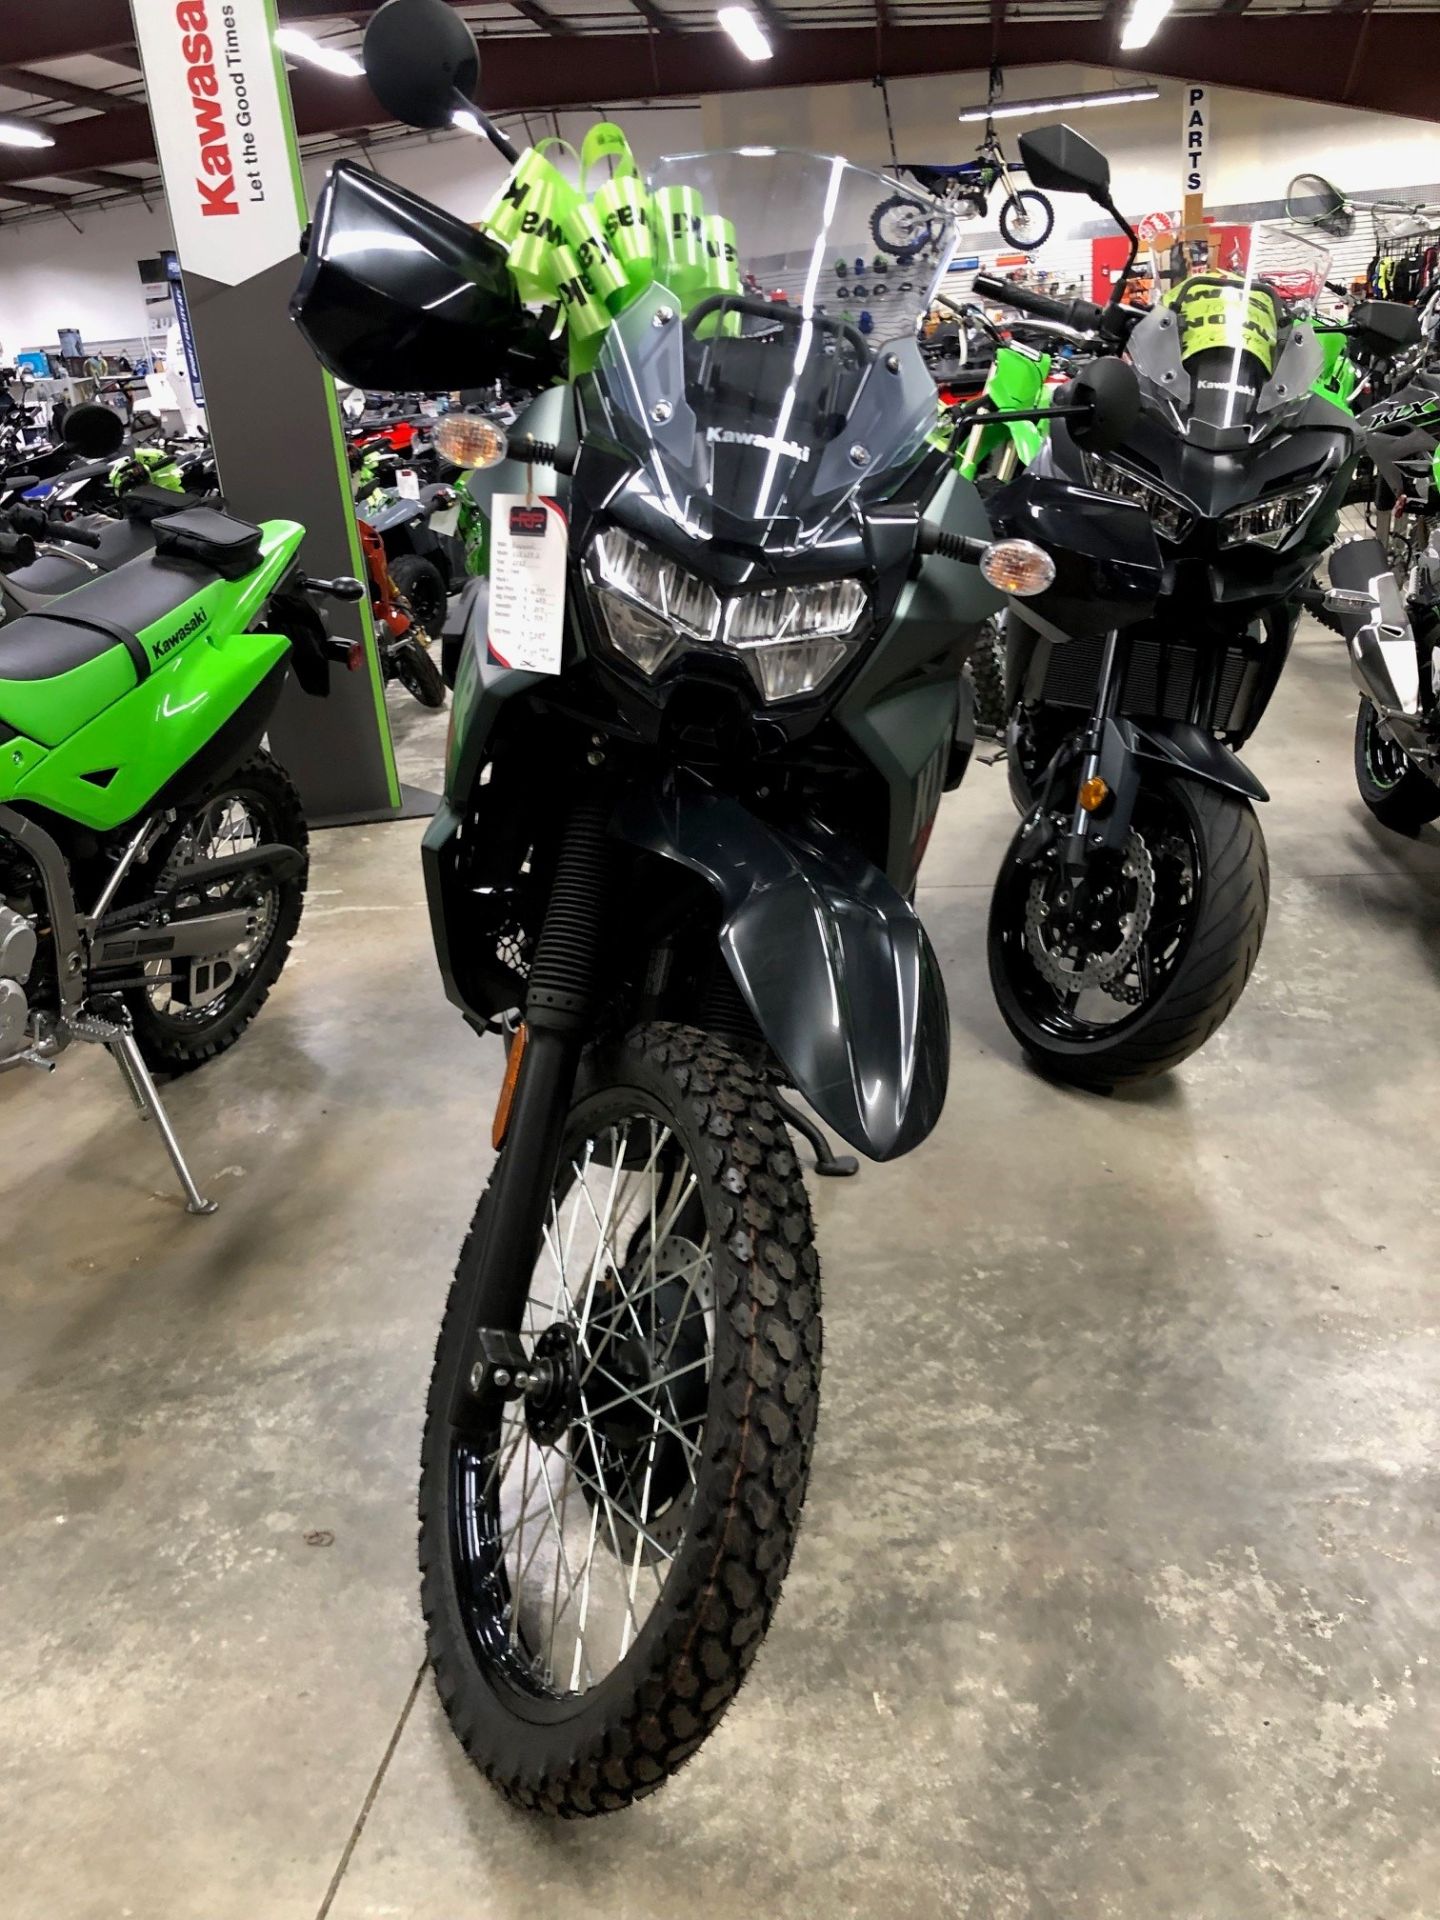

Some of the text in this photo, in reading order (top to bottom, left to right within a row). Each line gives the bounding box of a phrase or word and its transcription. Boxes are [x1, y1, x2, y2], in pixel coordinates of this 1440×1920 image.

[222, 5, 265, 202] Let the Good Times
[1188, 89, 1203, 190] PARTS
[1197, 380, 1255, 396] Kawaaki
[706, 426, 810, 462] Kawaki
[152, 606, 207, 660] Kawasaki
